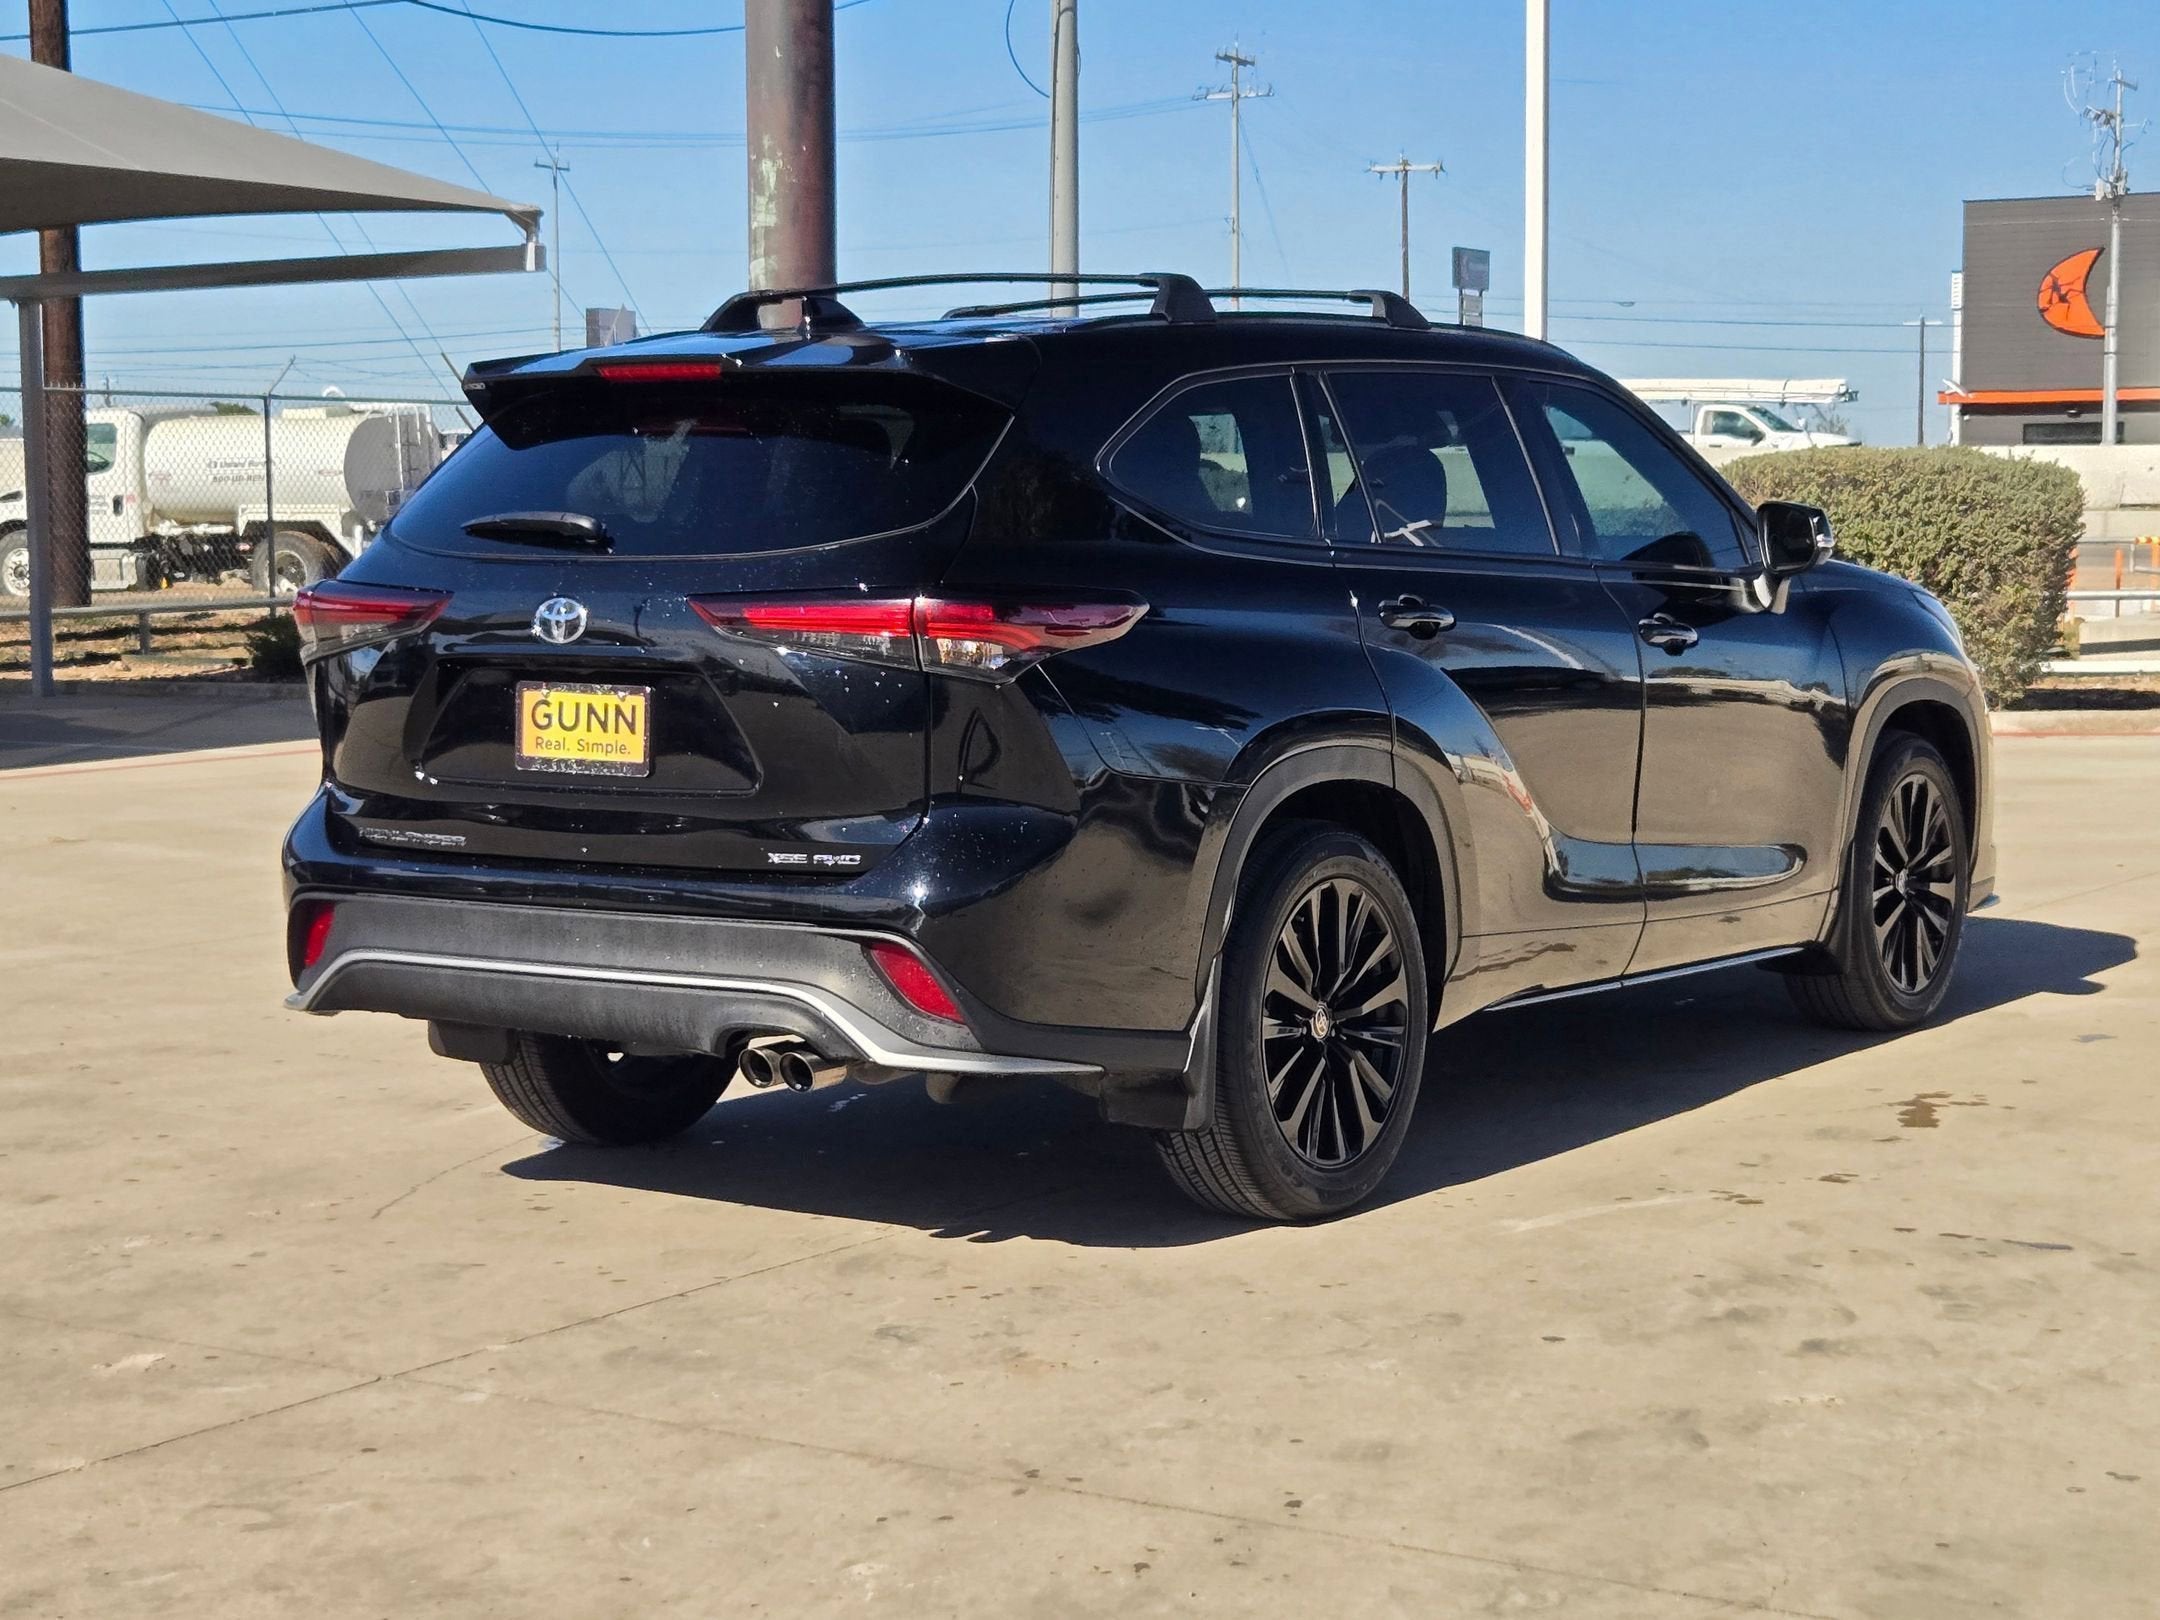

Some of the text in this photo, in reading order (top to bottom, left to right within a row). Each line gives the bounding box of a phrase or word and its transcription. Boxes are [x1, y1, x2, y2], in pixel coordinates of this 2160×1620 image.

[531, 699, 637, 735] GUNN
[535, 736, 631, 756] Real. Simple.
